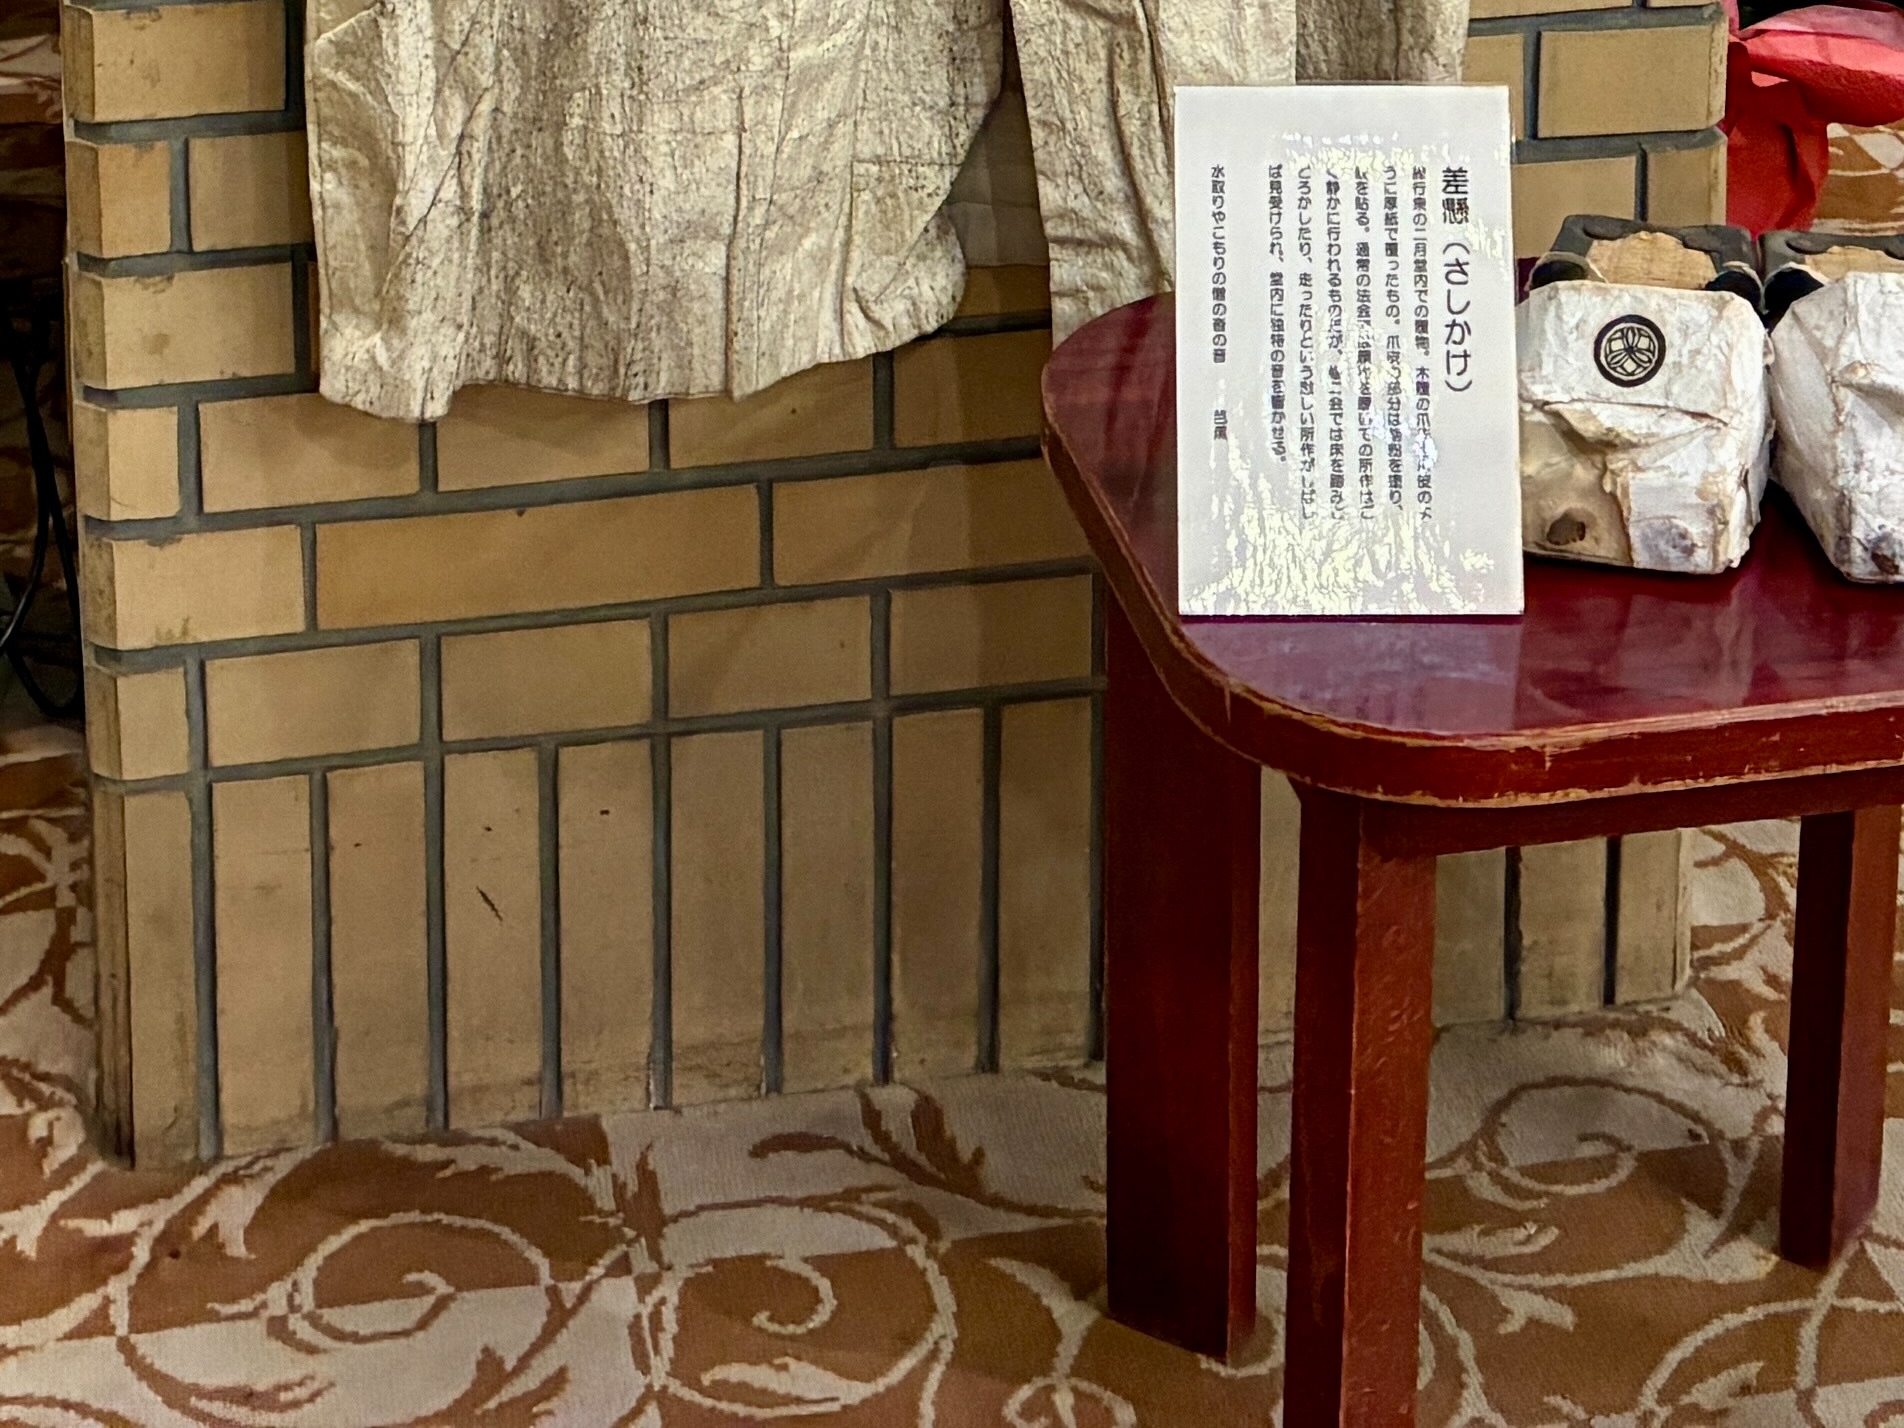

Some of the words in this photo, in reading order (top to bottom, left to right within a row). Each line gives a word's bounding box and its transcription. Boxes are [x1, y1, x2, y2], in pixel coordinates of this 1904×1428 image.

[1442, 166, 1474, 392] 差懸（さしかけ）
